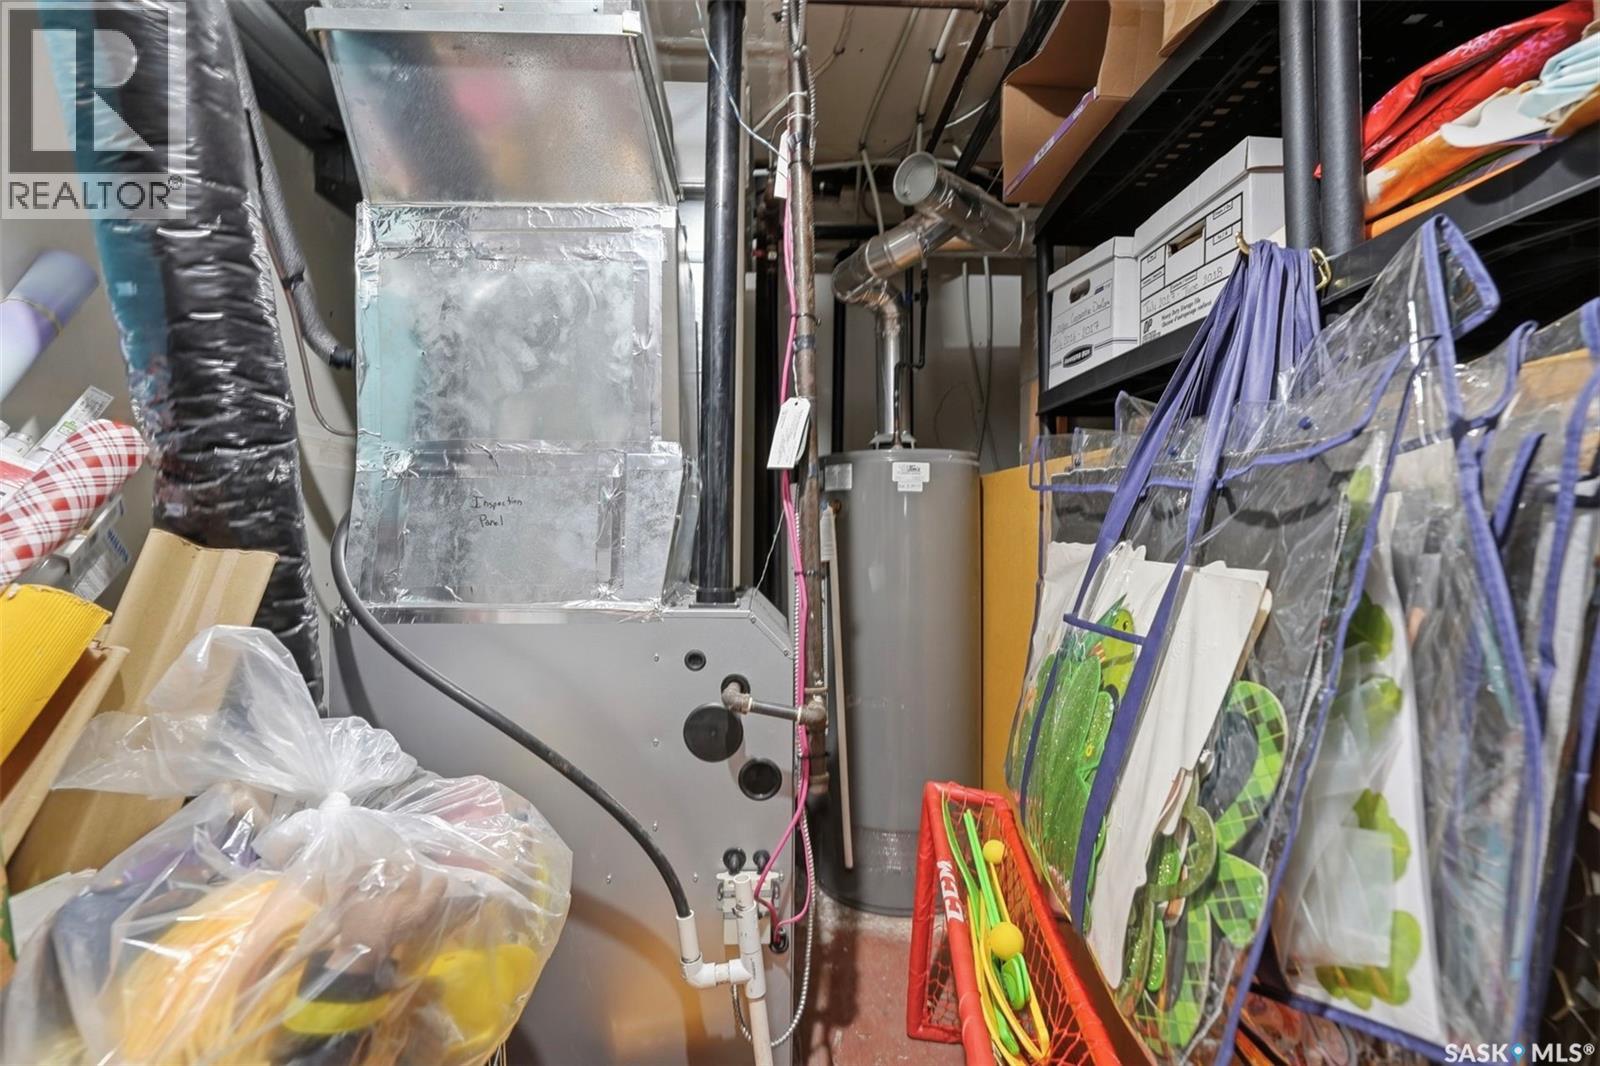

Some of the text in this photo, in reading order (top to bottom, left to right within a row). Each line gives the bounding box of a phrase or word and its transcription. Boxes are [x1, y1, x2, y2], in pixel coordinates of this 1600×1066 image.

[471, 495, 523, 510] Inspection
[479, 513, 504, 528] Panel
[936, 859, 965, 923] CCM
